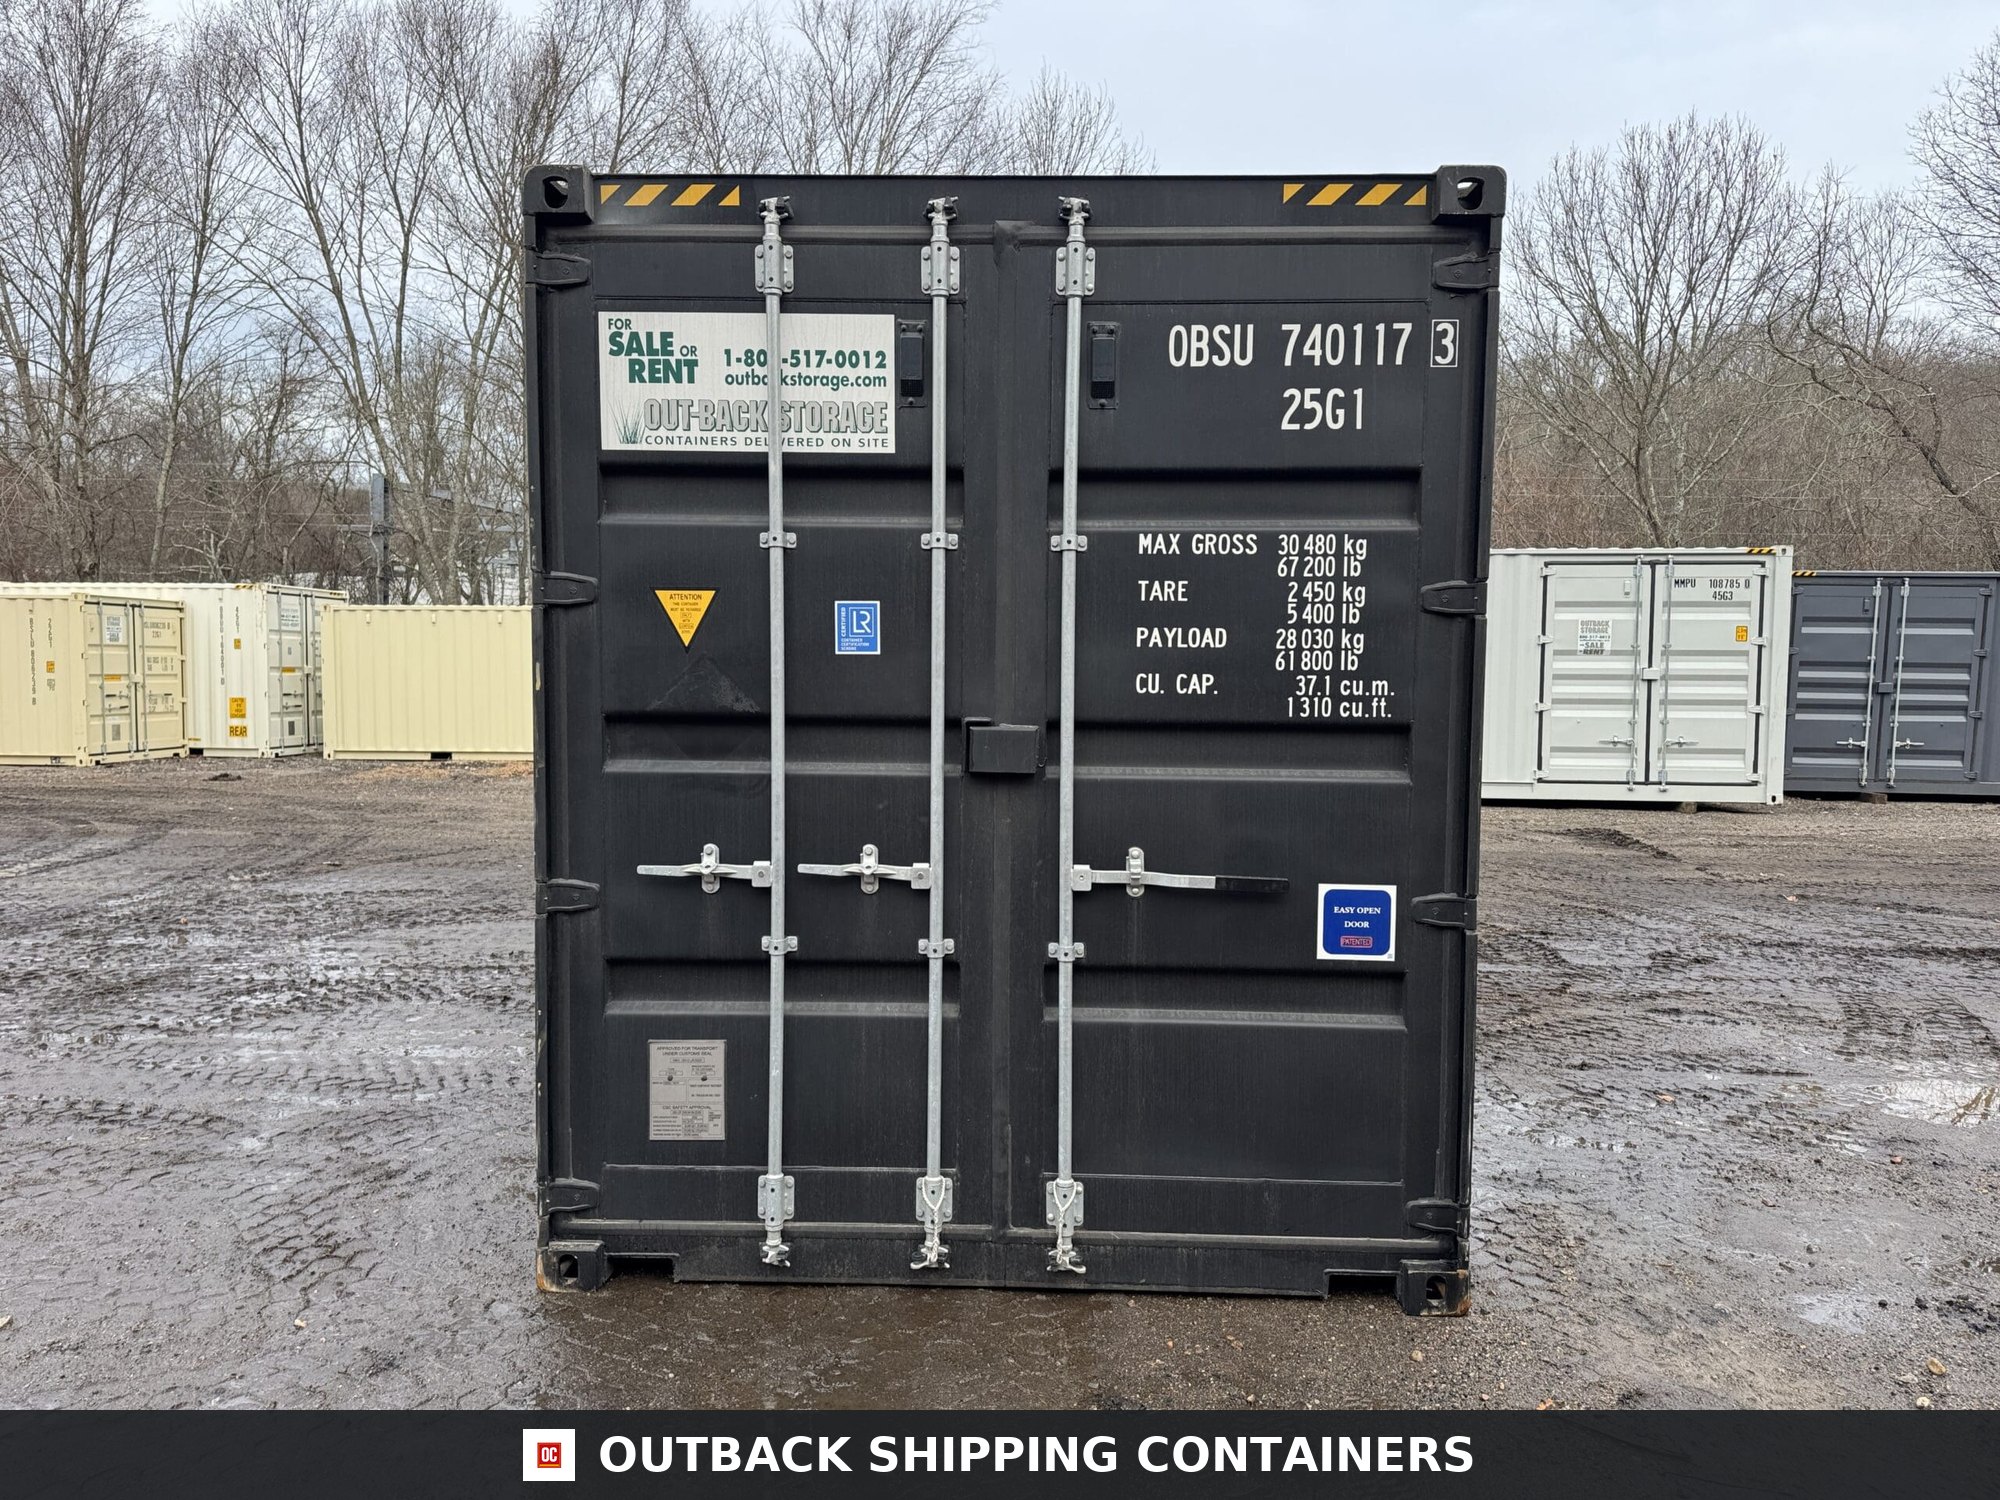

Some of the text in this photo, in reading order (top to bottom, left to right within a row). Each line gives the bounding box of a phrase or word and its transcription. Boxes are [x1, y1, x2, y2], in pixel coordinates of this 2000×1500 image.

[608, 319, 632, 330] FOR
[608, 331, 697, 357] SALE OR
[1168, 322, 1455, 367] OBSU 740117 3
[724, 349, 887, 369] 1-80-517-0012
[628, 359, 698, 384] RENT
[725, 369, 887, 391] outbakstorage.com
[643, 398, 888, 434] OUT-BACK STORAGE
[1281, 388, 1363, 430] 25G1
[645, 435, 737, 446] CONTAINERS
[831, 438, 851, 447] ON
[858, 438, 888, 448] SITE
[1138, 533, 1181, 555] MAX
[1191, 534, 1258, 555] GROSS
[1343, 534, 1367, 560] kg
[1343, 556, 1361, 577] lb
[1138, 580, 1188, 601] TARE
[1342, 581, 1366, 607] kg
[1674, 578, 1750, 589] MMPU 108785 0
[1712, 591, 1733, 601] 45G3
[1341, 604, 1360, 624] lb
[1136, 627, 1227, 648] PAYLOAD
[1341, 628, 1365, 654] kg
[1340, 651, 1359, 671] lb
[1135, 673, 1395, 696] CU. CAP. 37.1 cu.m.
[1339, 697, 1392, 718] cu.ft.
[229, 726, 247, 737] REAR
[1334, 906, 1355, 914] EASY
[1344, 920, 1370, 928] DOOR
[1342, 938, 1371, 946] PATENTED
